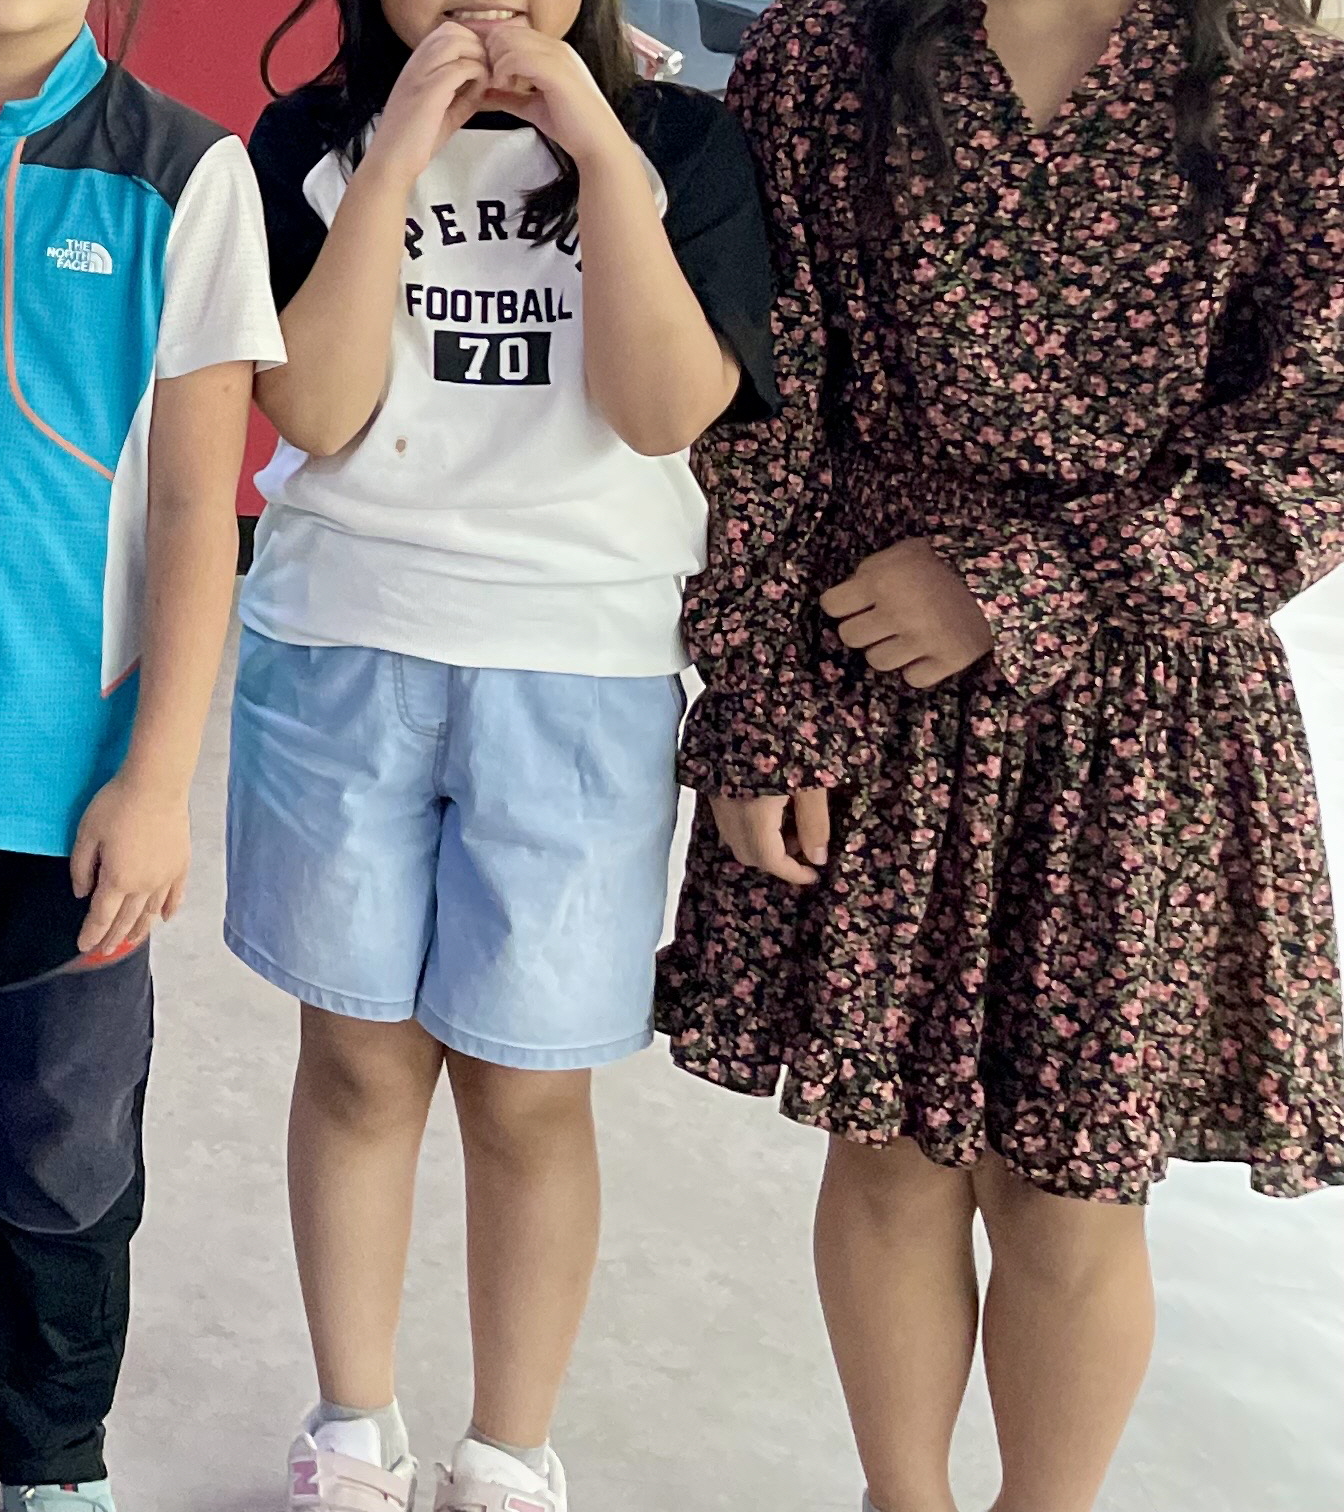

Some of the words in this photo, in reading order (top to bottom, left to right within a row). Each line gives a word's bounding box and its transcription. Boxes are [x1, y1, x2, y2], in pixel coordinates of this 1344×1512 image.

[65, 238, 91, 251] THE
[46, 246, 91, 262] NORTH
[56, 258, 89, 272] FACE
[405, 283, 573, 324] FOOTBALL
[458, 336, 529, 381] 70
